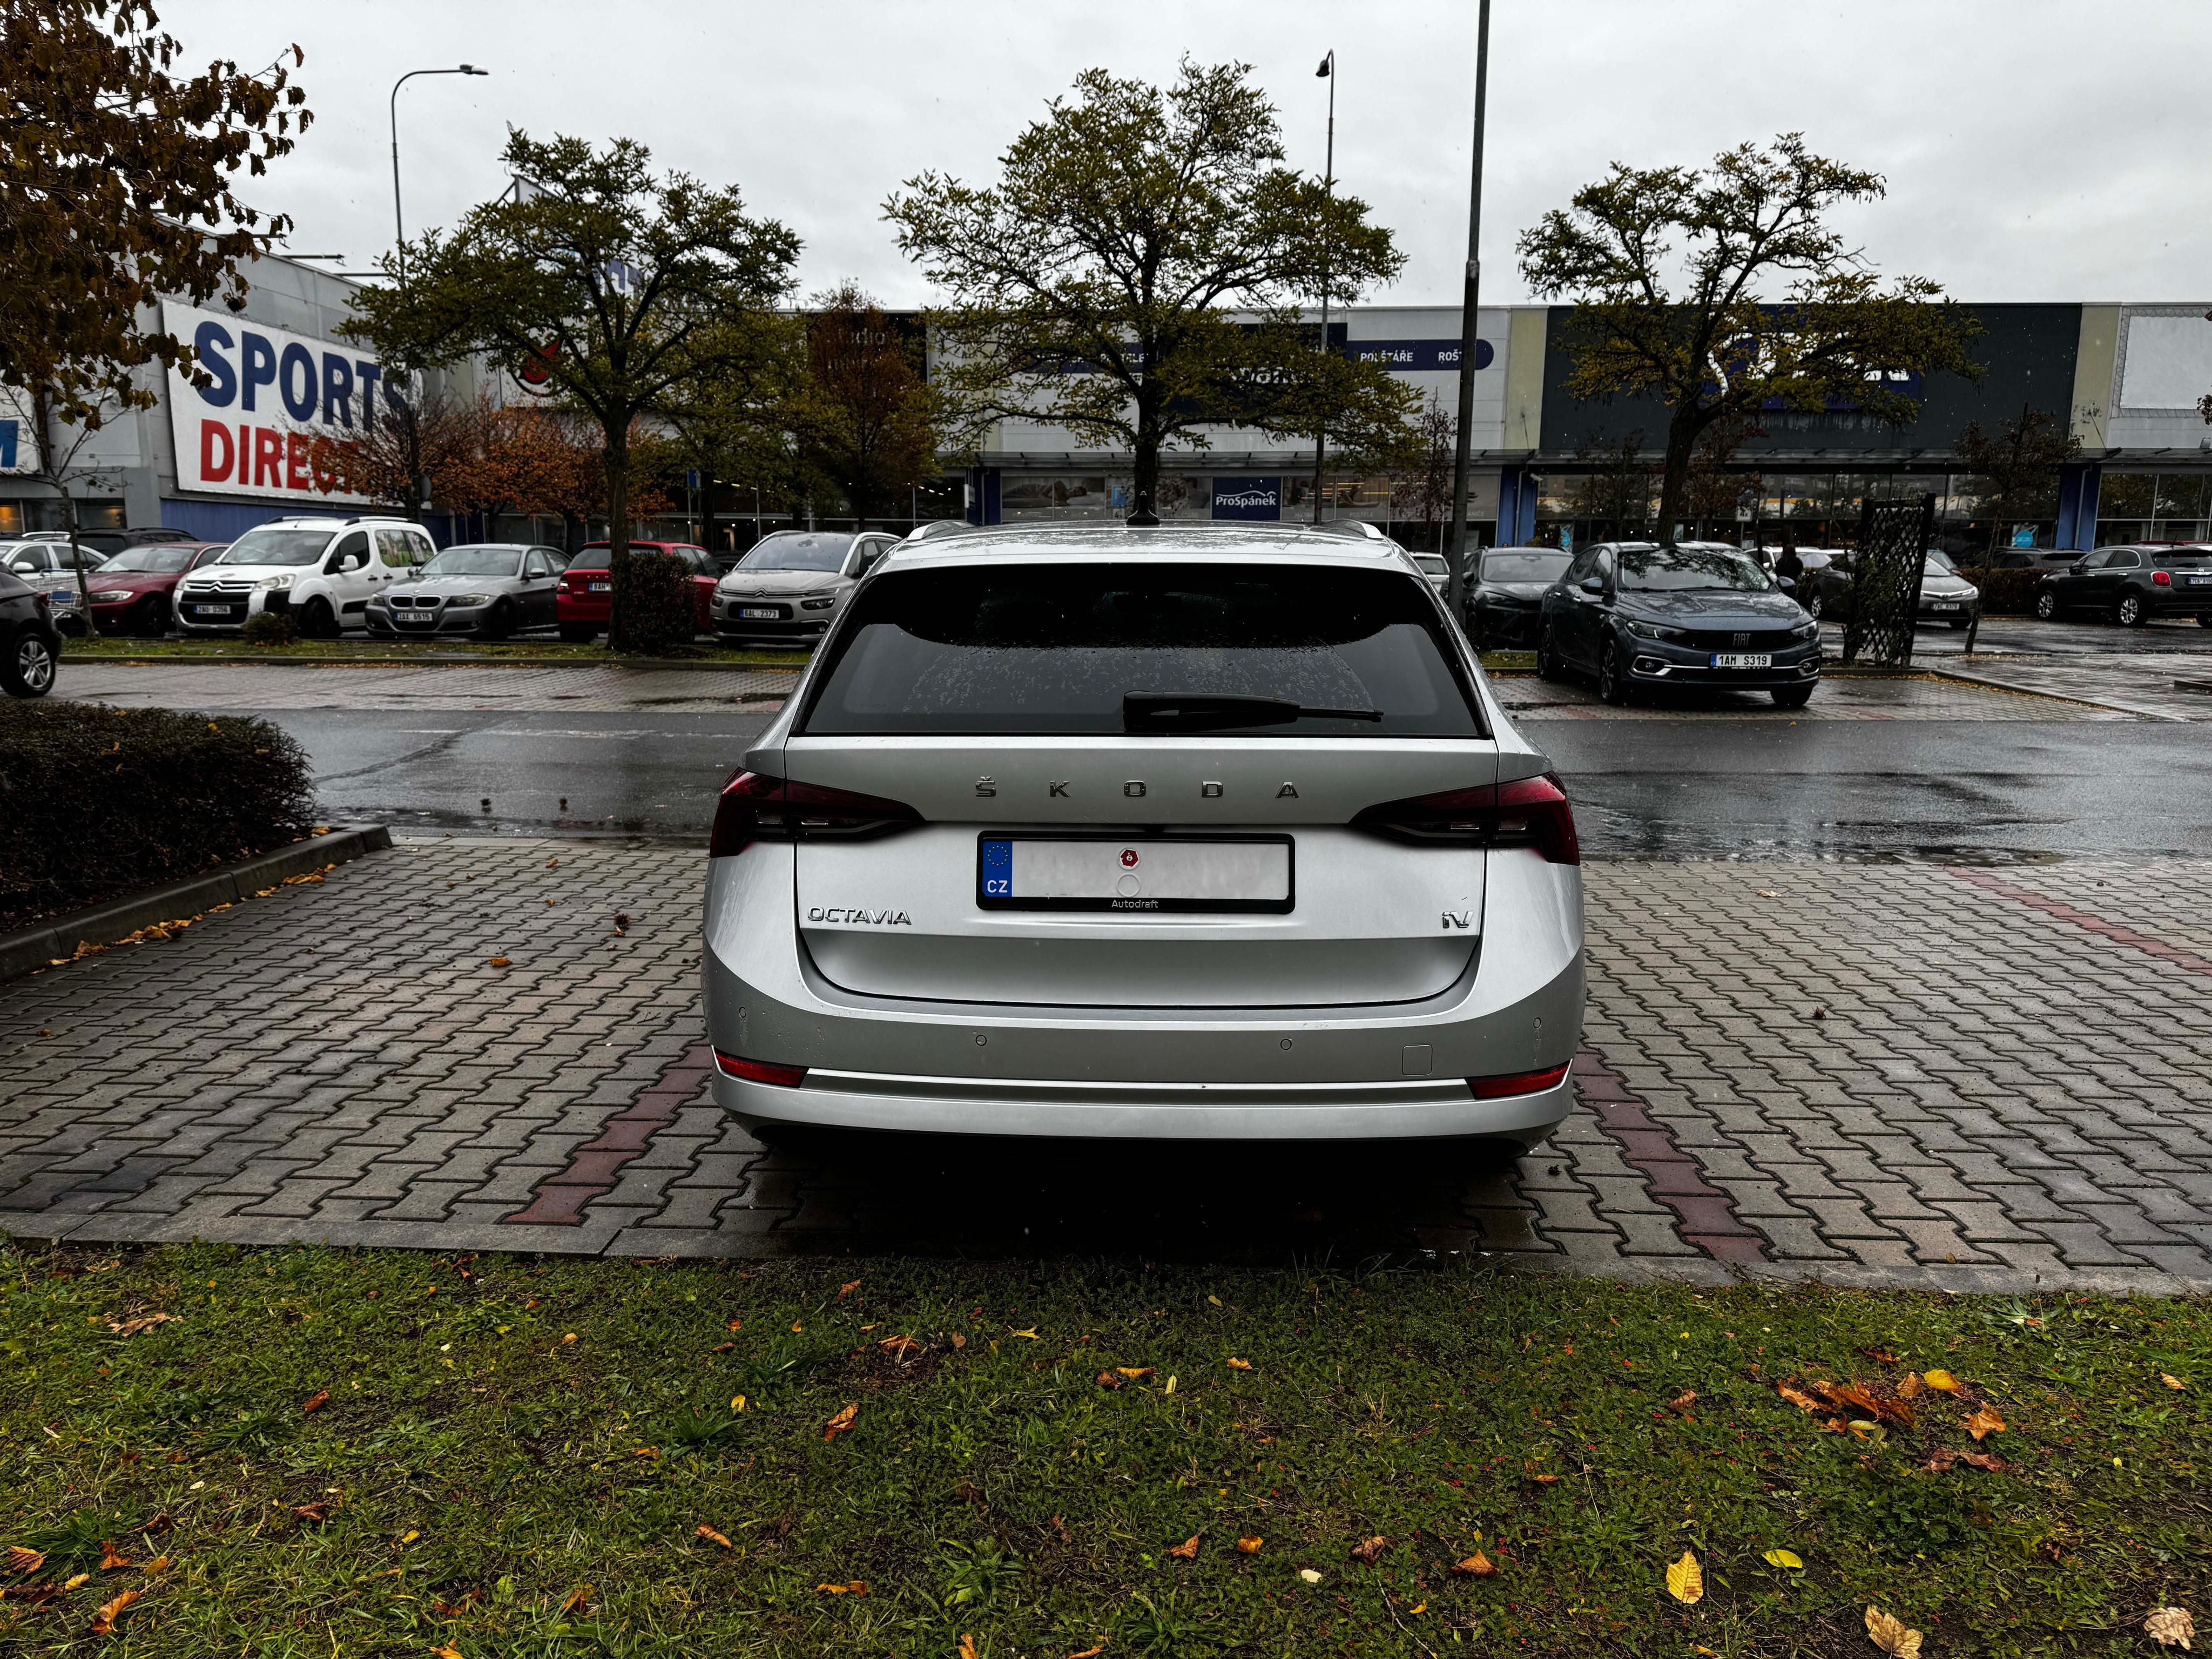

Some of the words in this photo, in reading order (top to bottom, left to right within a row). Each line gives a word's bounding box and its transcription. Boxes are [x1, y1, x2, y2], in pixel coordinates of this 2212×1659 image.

[1360, 350, 1413, 362] POLŠTÁŘE
[1216, 495, 1276, 508] ProSpánek
[1732, 633, 1751, 646] FIAT
[1719, 655, 1736, 665] 1AM
[1744, 655, 1767, 665] S319
[975, 775, 1299, 798] ŠKODA
[987, 879, 1008, 893] CZ
[1111, 900, 1158, 908] Autodraft
[808, 907, 912, 926] OCTAVIA
